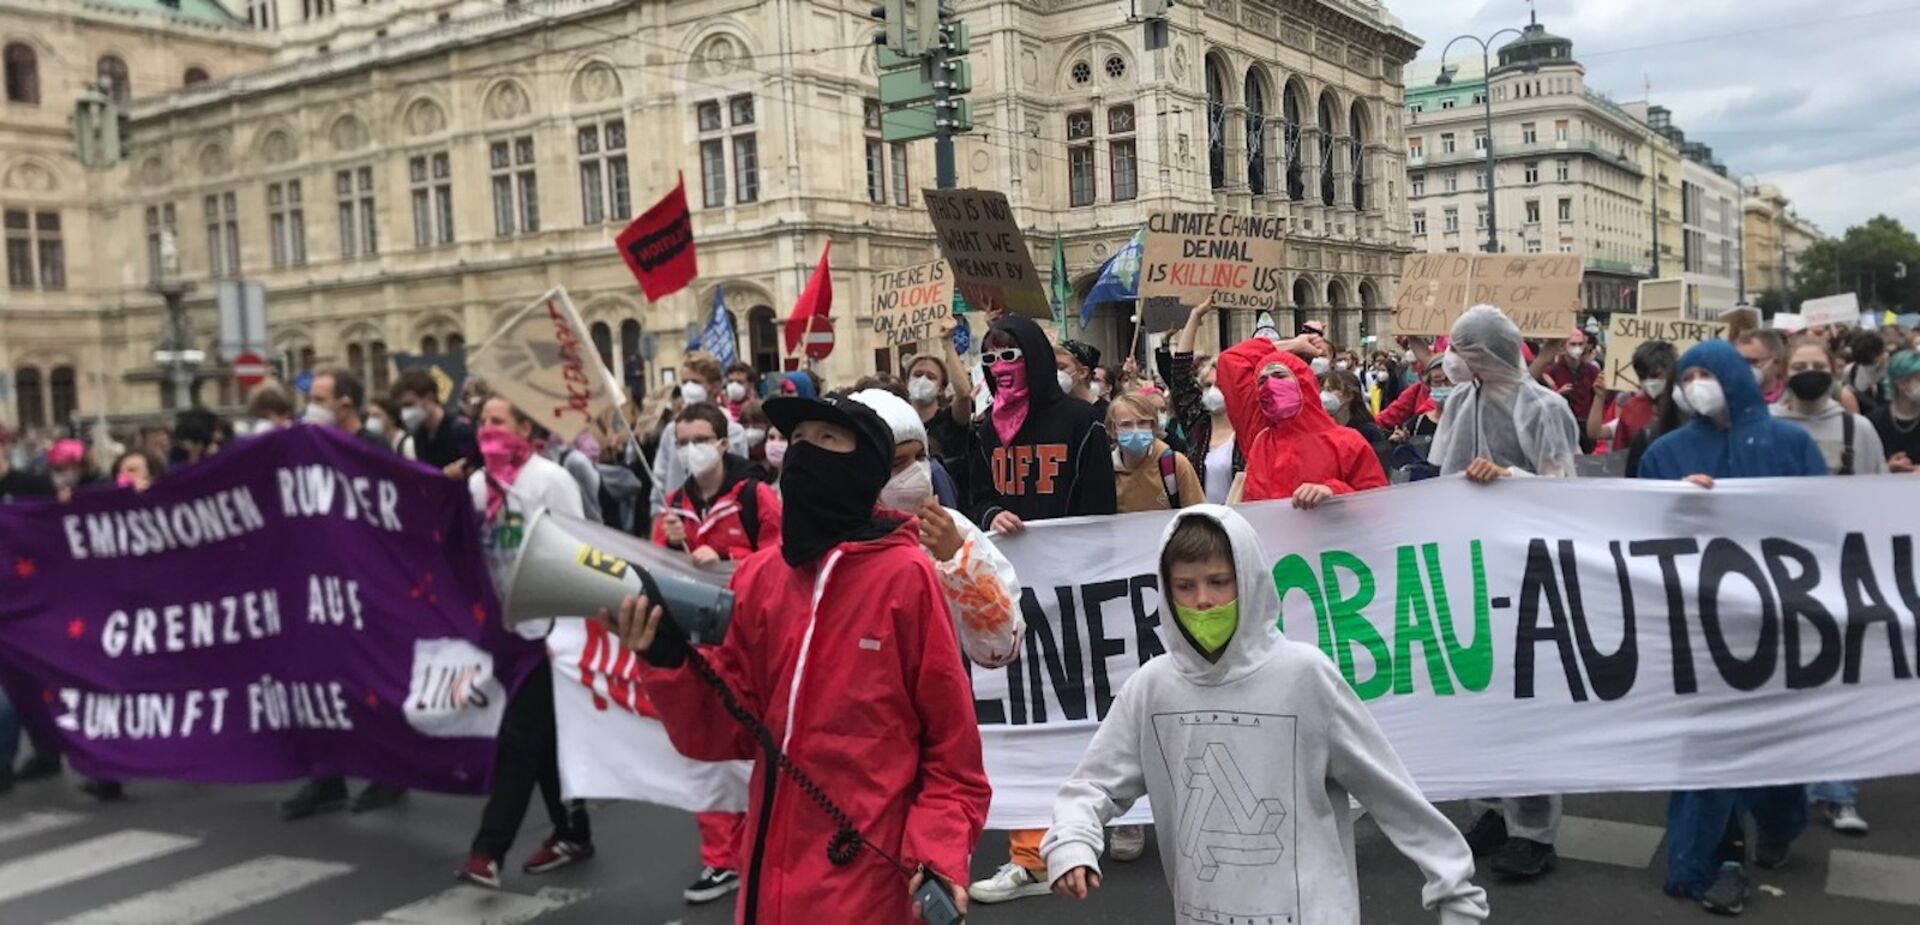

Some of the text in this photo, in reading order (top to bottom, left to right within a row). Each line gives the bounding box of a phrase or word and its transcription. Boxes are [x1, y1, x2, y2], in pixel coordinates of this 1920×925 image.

[925, 194, 1009, 221] THIS IS NOT
[940, 228, 1017, 253] WHAT WE
[1149, 213, 1287, 241] CLIMATE CHANGE
[1183, 239, 1253, 262] DENIAL
[878, 261, 944, 291] THERE IS
[955, 259, 1022, 280] MEANT BY
[1147, 262, 1279, 293] IS KILLING US
[1452, 256, 1494, 279] DIE
[876, 290, 899, 313] NO
[900, 282, 945, 308] LOVE
[1510, 286, 1541, 304] OF
[874, 304, 947, 333] ON A DEAD
[886, 322, 933, 346] PLANET
[63, 485, 264, 559] EMISSIONEN
[102, 589, 281, 658] GRENZEN
[1272, 531, 1920, 702] OBAU-AUTOBA
